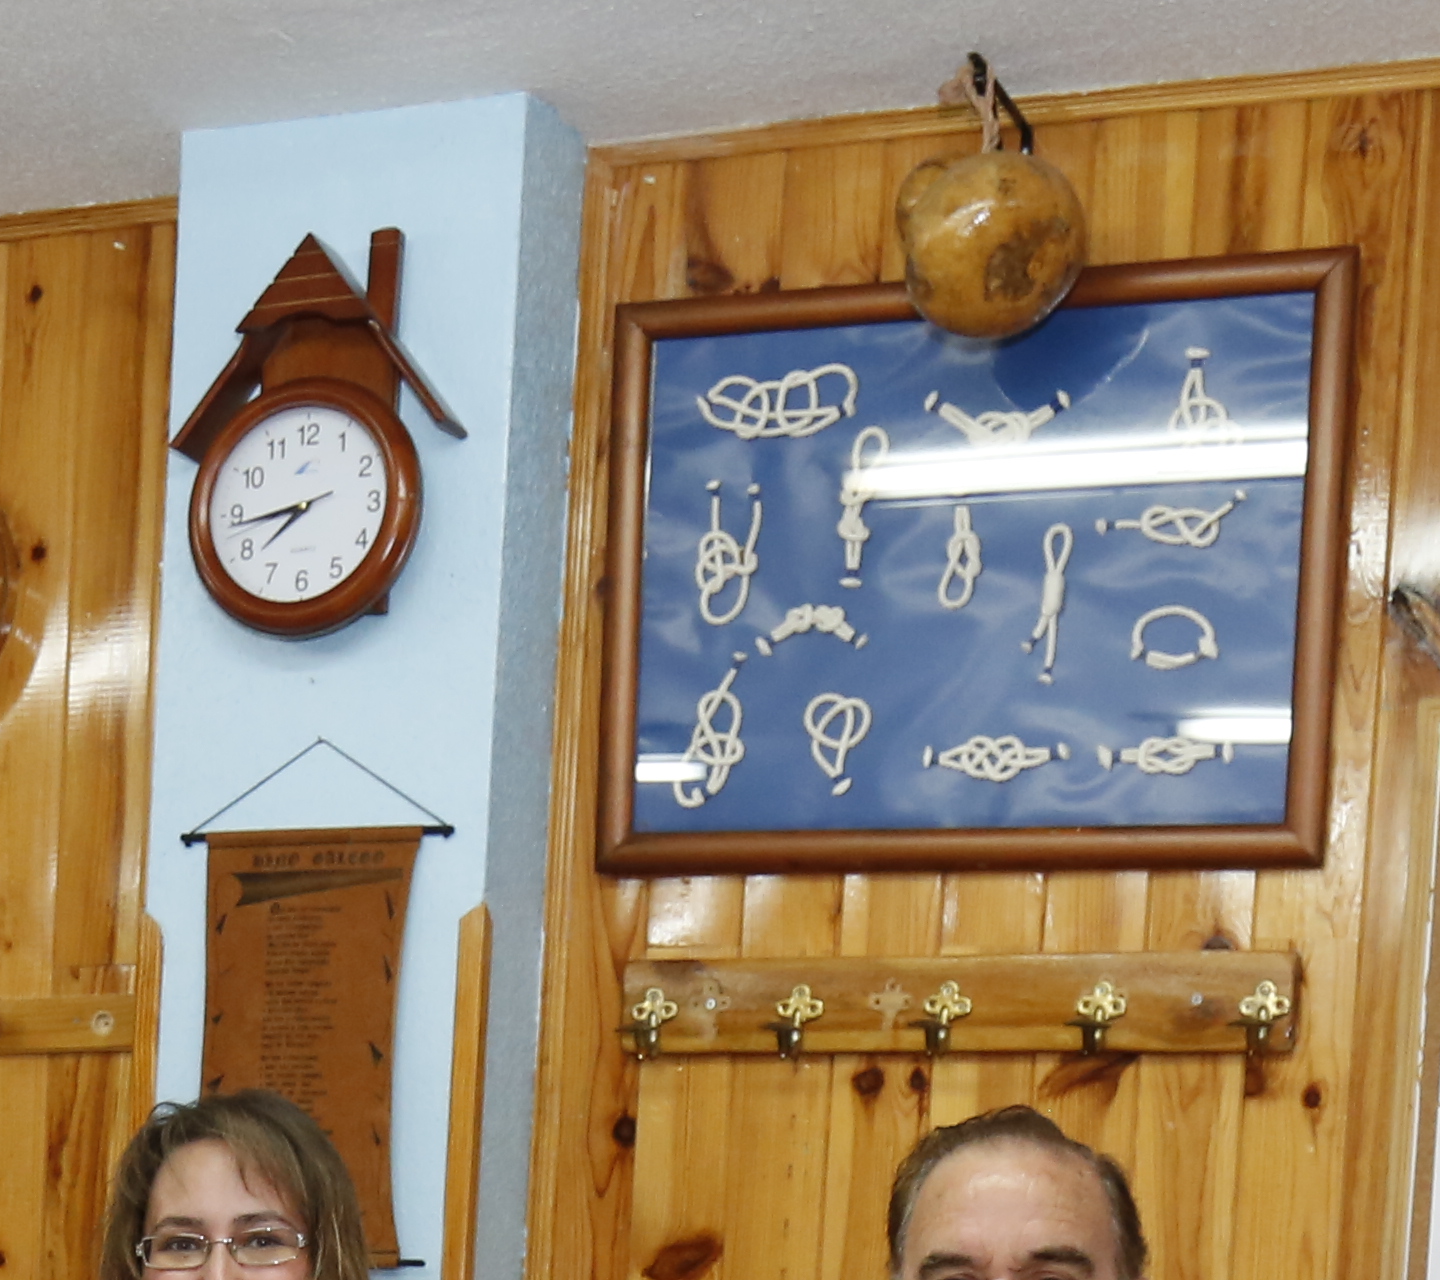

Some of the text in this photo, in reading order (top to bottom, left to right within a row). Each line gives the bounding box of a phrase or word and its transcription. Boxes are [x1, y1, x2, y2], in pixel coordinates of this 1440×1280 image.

[297, 424, 320, 446] 12
[339, 432, 346, 452] 1
[267, 438, 286, 459] 11
[359, 455, 373, 477] 2
[243, 467, 264, 489] 10
[367, 490, 381, 512] 3
[230, 504, 244, 526] 9
[241, 538, 253, 560] 8
[355, 528, 368, 549] 4
[266, 563, 278, 584] 7
[329, 557, 343, 578] 5
[295, 570, 308, 592] 6
